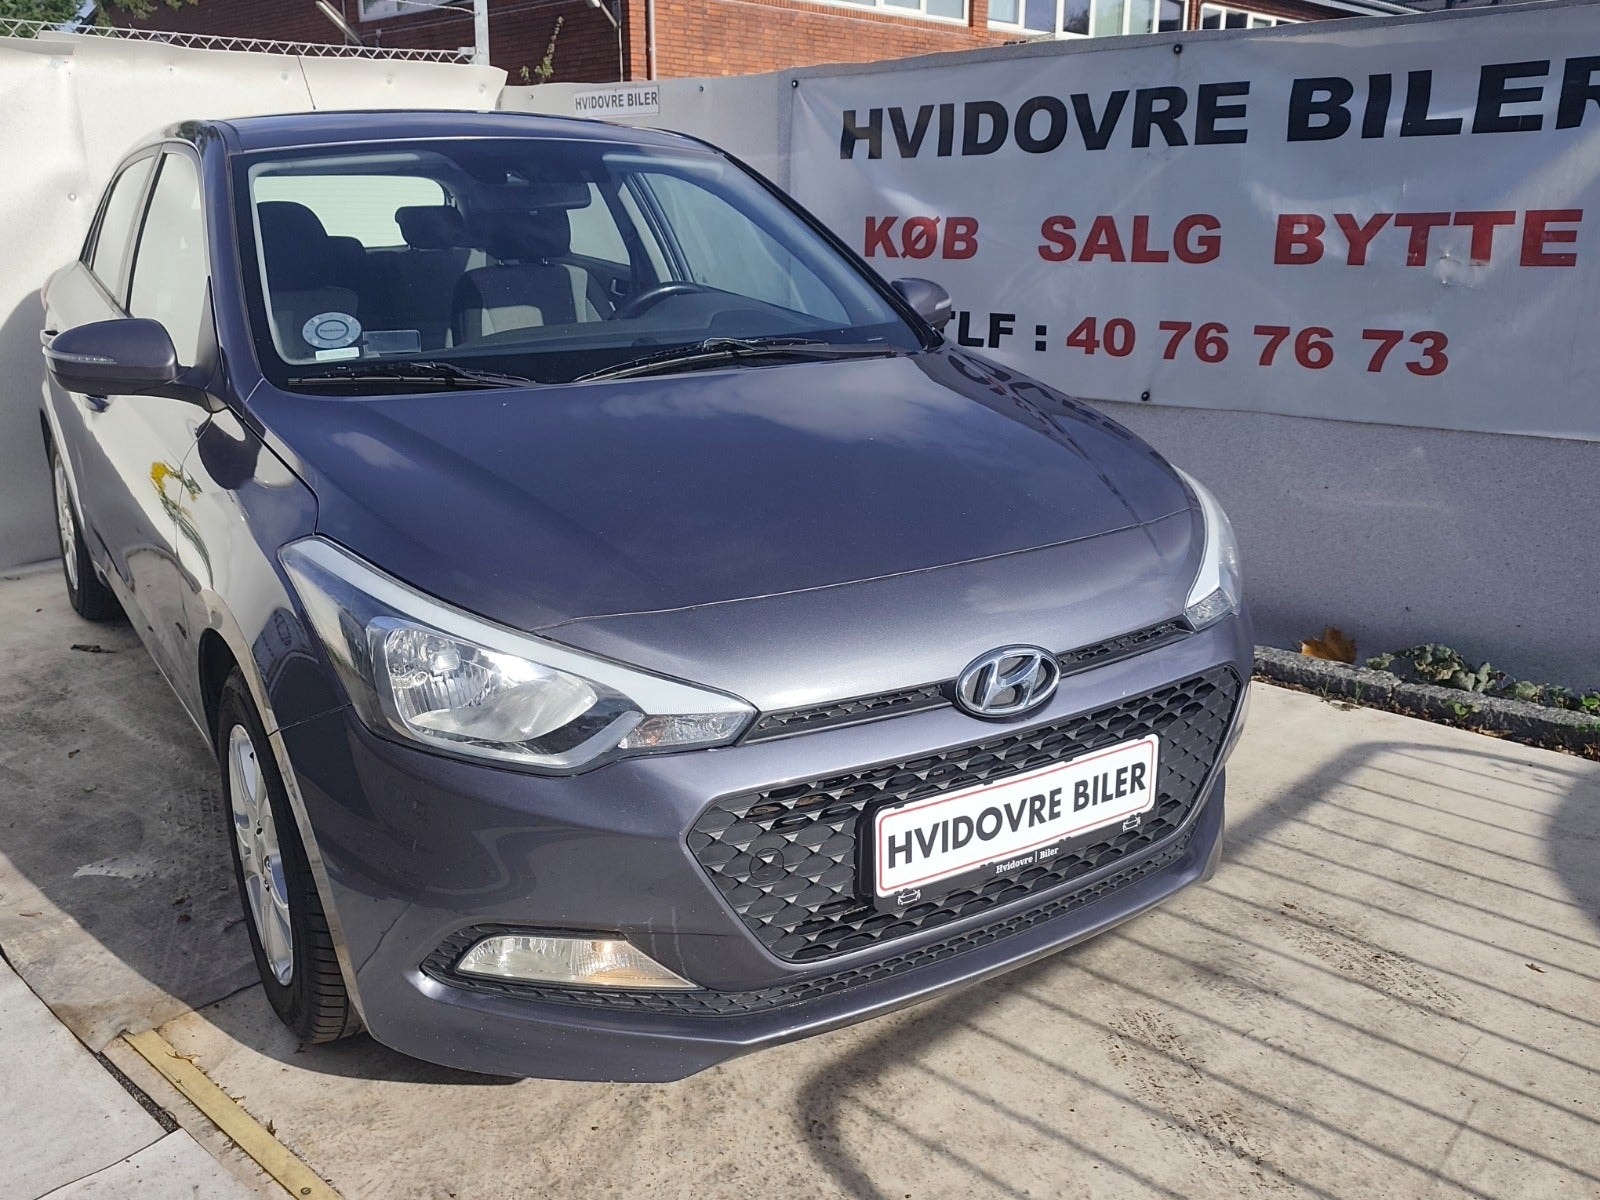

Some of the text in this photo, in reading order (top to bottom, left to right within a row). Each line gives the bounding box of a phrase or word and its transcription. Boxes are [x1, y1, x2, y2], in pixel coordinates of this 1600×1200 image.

[575, 91, 658, 110] HVIDOVRE BILER
[840, 55, 1600, 160] HVIDOVRE BILER
[866, 211, 1581, 267] KØB SALG BYTTE
[1067, 319, 1134, 357] 40
[1162, 323, 1227, 363] 76
[1255, 326, 1333, 369] 76
[1365, 331, 1447, 376] 73
[888, 762, 1146, 869] HVIDOVRE BILER
[995, 847, 1060, 874] Hvidovre Biler
